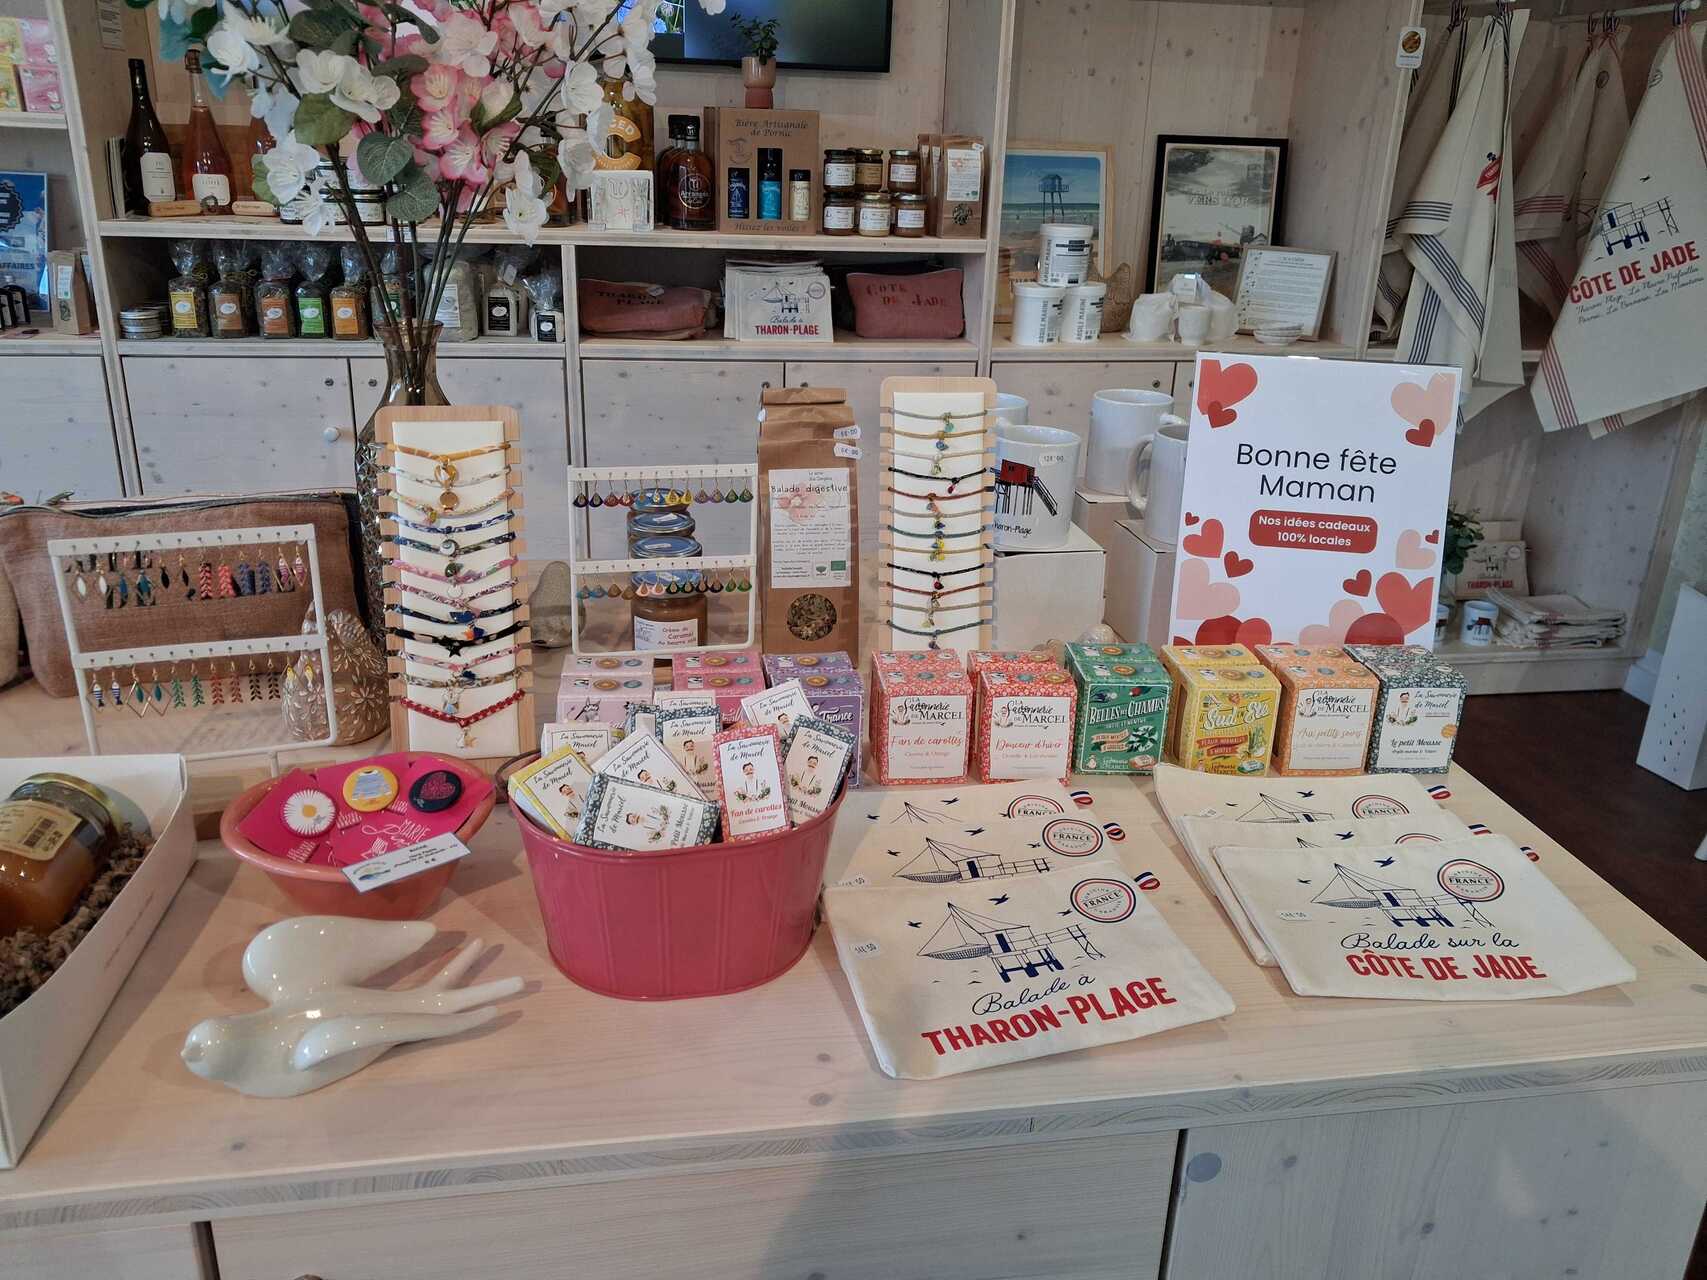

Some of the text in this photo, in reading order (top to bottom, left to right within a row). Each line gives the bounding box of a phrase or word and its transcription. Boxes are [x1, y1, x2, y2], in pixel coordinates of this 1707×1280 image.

[764, 119, 810, 129] Artisanale
[1569, 241, 1700, 304] CÔTE DE JADE
[754, 324, 820, 335] THARON-PLAGE
[1236, 443, 1398, 477] Bonne fête
[1259, 475, 1376, 505] Maman
[1258, 515, 1371, 534] Nos idées cadeaux
[1277, 532, 1352, 547] 100% locales
[768, 690, 797, 707] Savonnerie
[772, 700, 794, 713] Marcel
[904, 698, 951, 716] Savonnerie
[1414, 699, 1450, 709] de Marcel
[919, 711, 963, 721] MARCEL
[1090, 706, 1121, 724] BELLES
[1128, 697, 1165, 718] CHAMPS
[1325, 704, 1370, 713] MARCEL
[680, 719, 712, 728] Savonnerie
[1022, 713, 1065, 723] MARCEL
[1203, 706, 1237, 730] Sud
[560, 732, 604, 740] La Savonnerie
[672, 727, 706, 737] de Marcel
[804, 730, 844, 750] La Savonnerie
[572, 740, 599, 748] Marcel
[737, 739, 770, 749] Savonnerie
[809, 741, 836, 757] Marcel
[613, 741, 650, 771] La Savonnerie
[729, 748, 765, 761] de Marcel
[533, 759, 573, 785] La Savonnerie
[621, 752, 650, 778] de Marcel
[542, 768, 574, 791] de Marcel
[601, 786, 617, 824] Savonnerie
[611, 796, 626, 834] de Marcel
[1053, 832, 1091, 841] FRANCE
[1448, 877, 1490, 885] FRANCE
[1082, 891, 1121, 909] FRANCE
[1341, 931, 1520, 951] Balade sur la
[1345, 948, 1547, 981] CÔTE DE JADE
[971, 977, 1071, 1016] Balade
[920, 976, 1177, 1056] THARON-PLAGE
